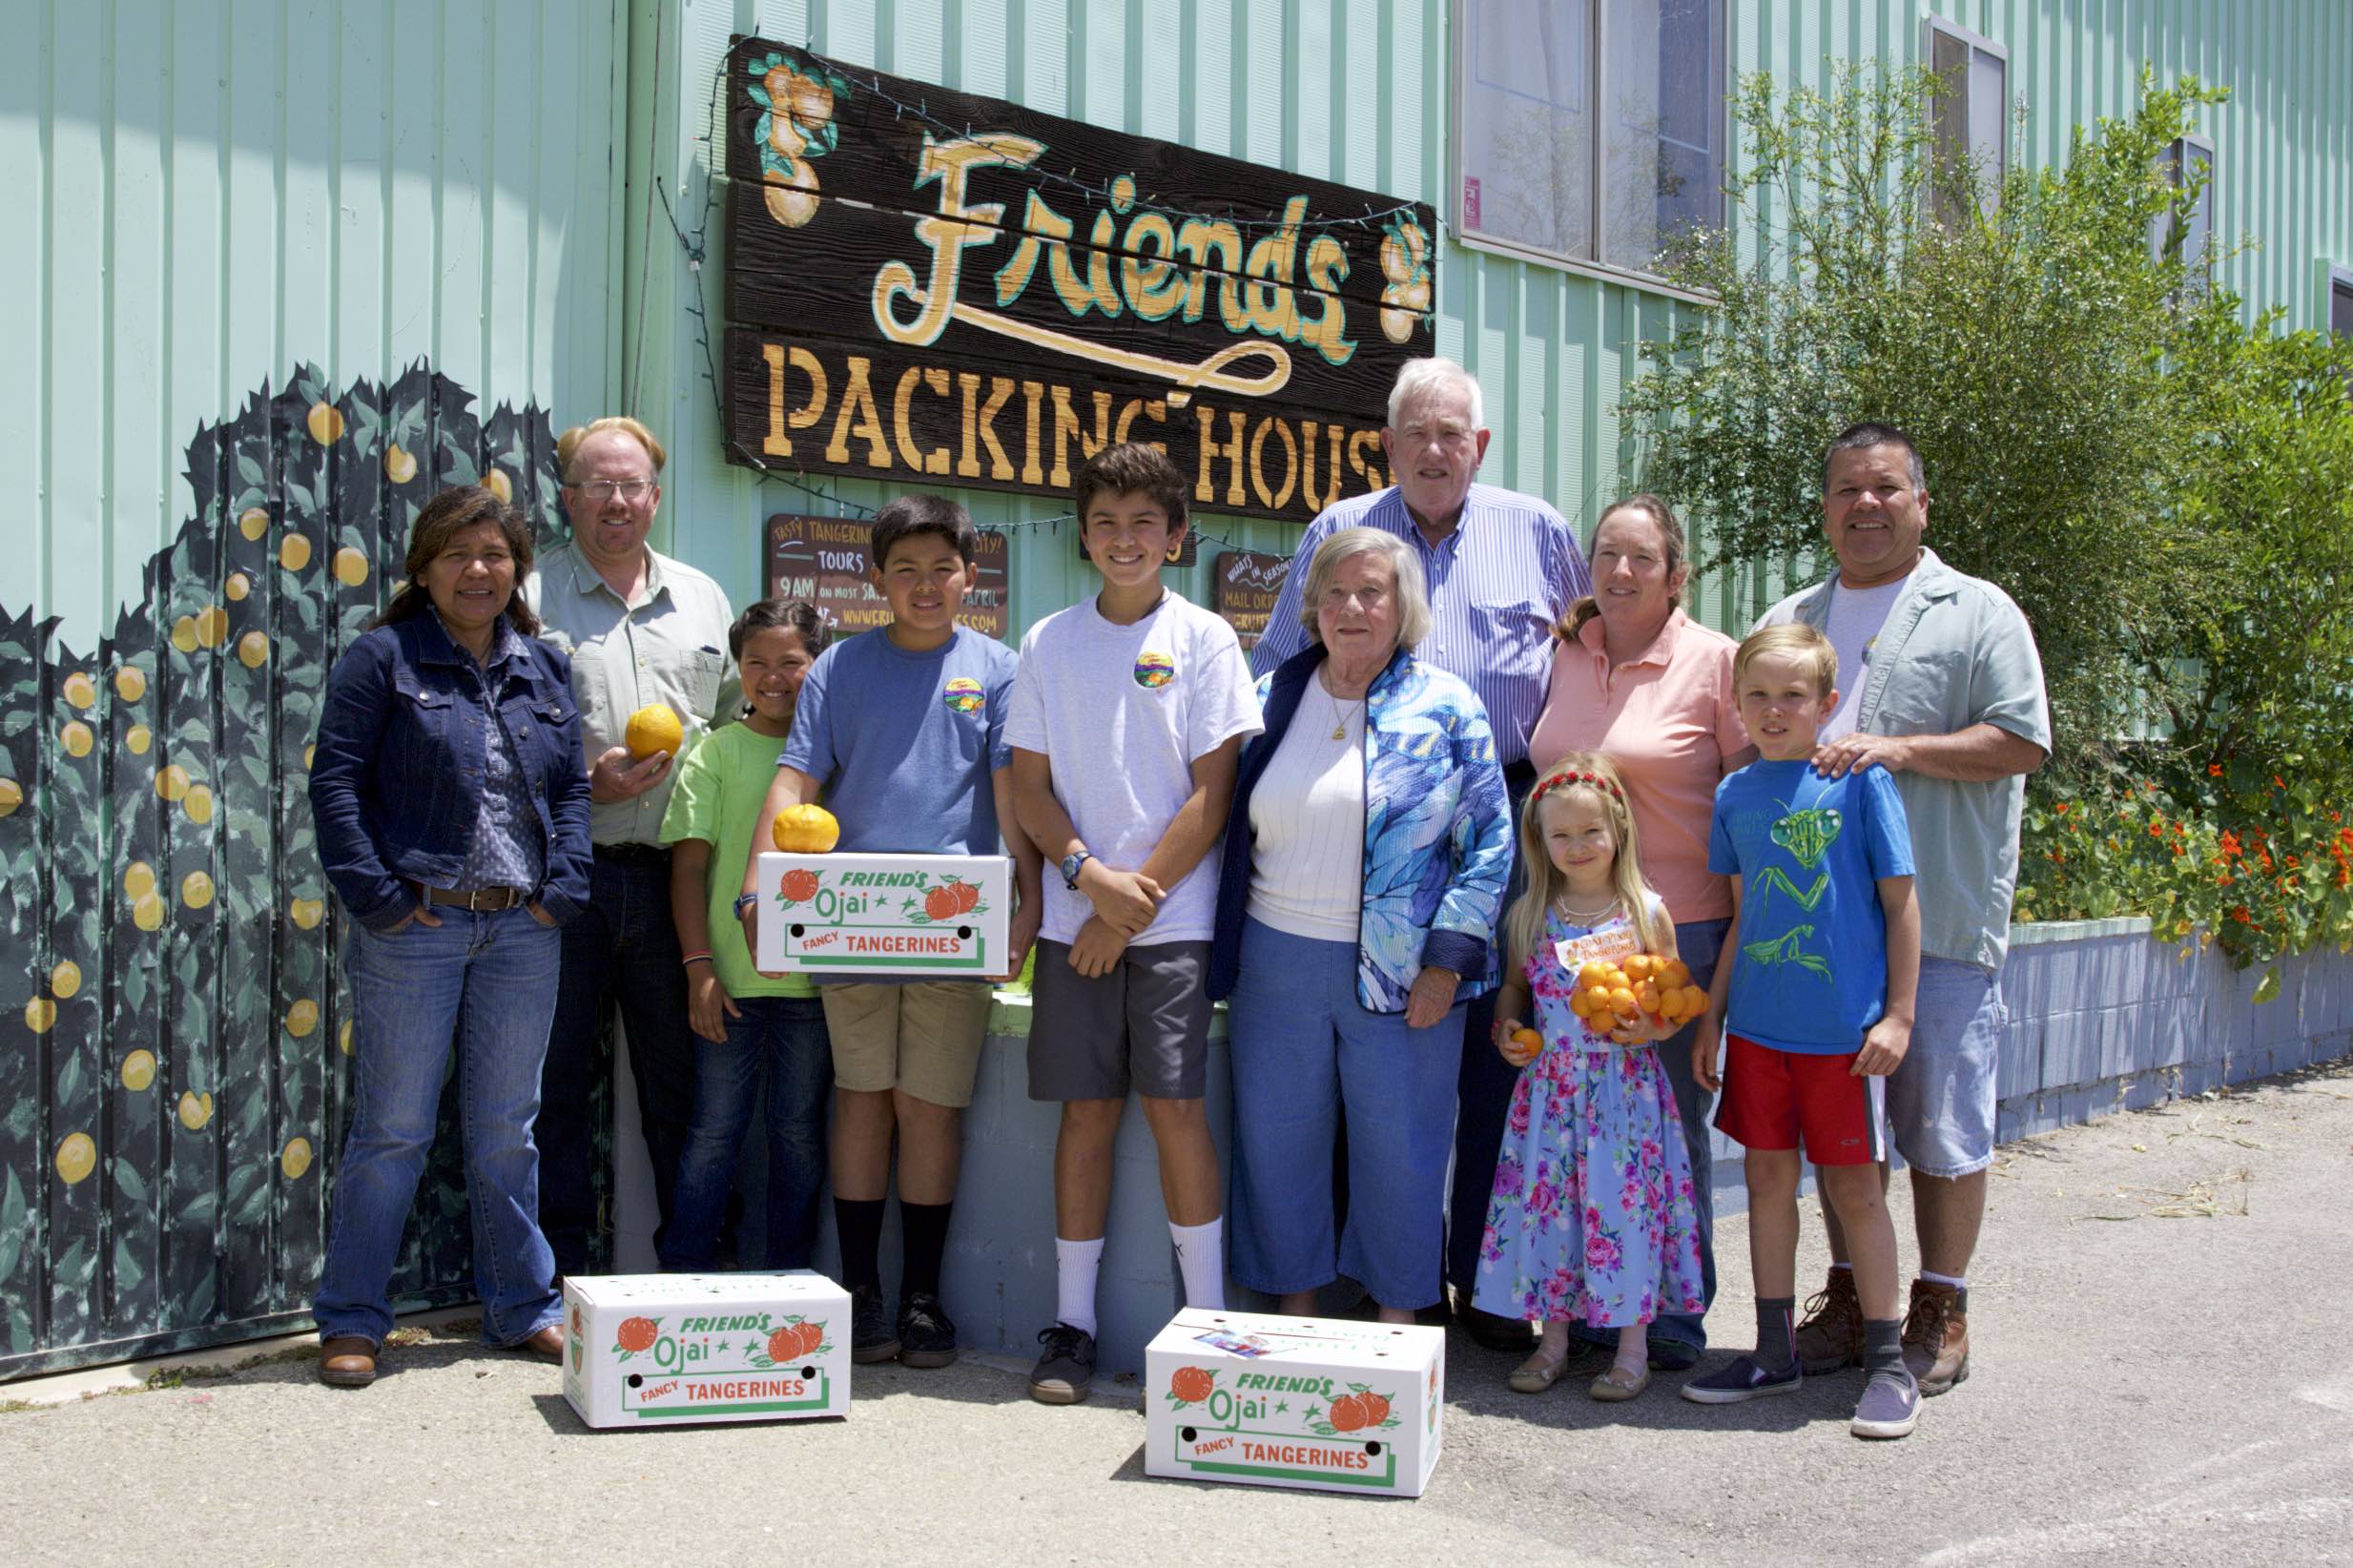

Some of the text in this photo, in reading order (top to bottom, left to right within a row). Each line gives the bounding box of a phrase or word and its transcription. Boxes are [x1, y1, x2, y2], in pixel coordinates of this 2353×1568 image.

[872, 130, 1358, 368] Friends
[1195, 405, 1396, 513] HOUS
[774, 520, 873, 544] TASTY TANGERIN
[818, 550, 864, 573] TOURS
[820, 588, 832, 599] ON
[835, 588, 857, 599] MOST
[1225, 591, 1250, 609] MAIL
[839, 870, 929, 888] FRIEND'S
[815, 888, 869, 925] Ojai
[802, 931, 960, 954] FANCY TANGERINES
[680, 1311, 773, 1333] FRIEND'S
[654, 1336, 710, 1374] Ojai
[641, 1379, 805, 1402] FANCY TANGERINES
[1236, 1372, 1334, 1396] FRIEND'S
[1208, 1389, 1267, 1431] Ojai
[1194, 1436, 1369, 1470] FANCY TANGERINES
